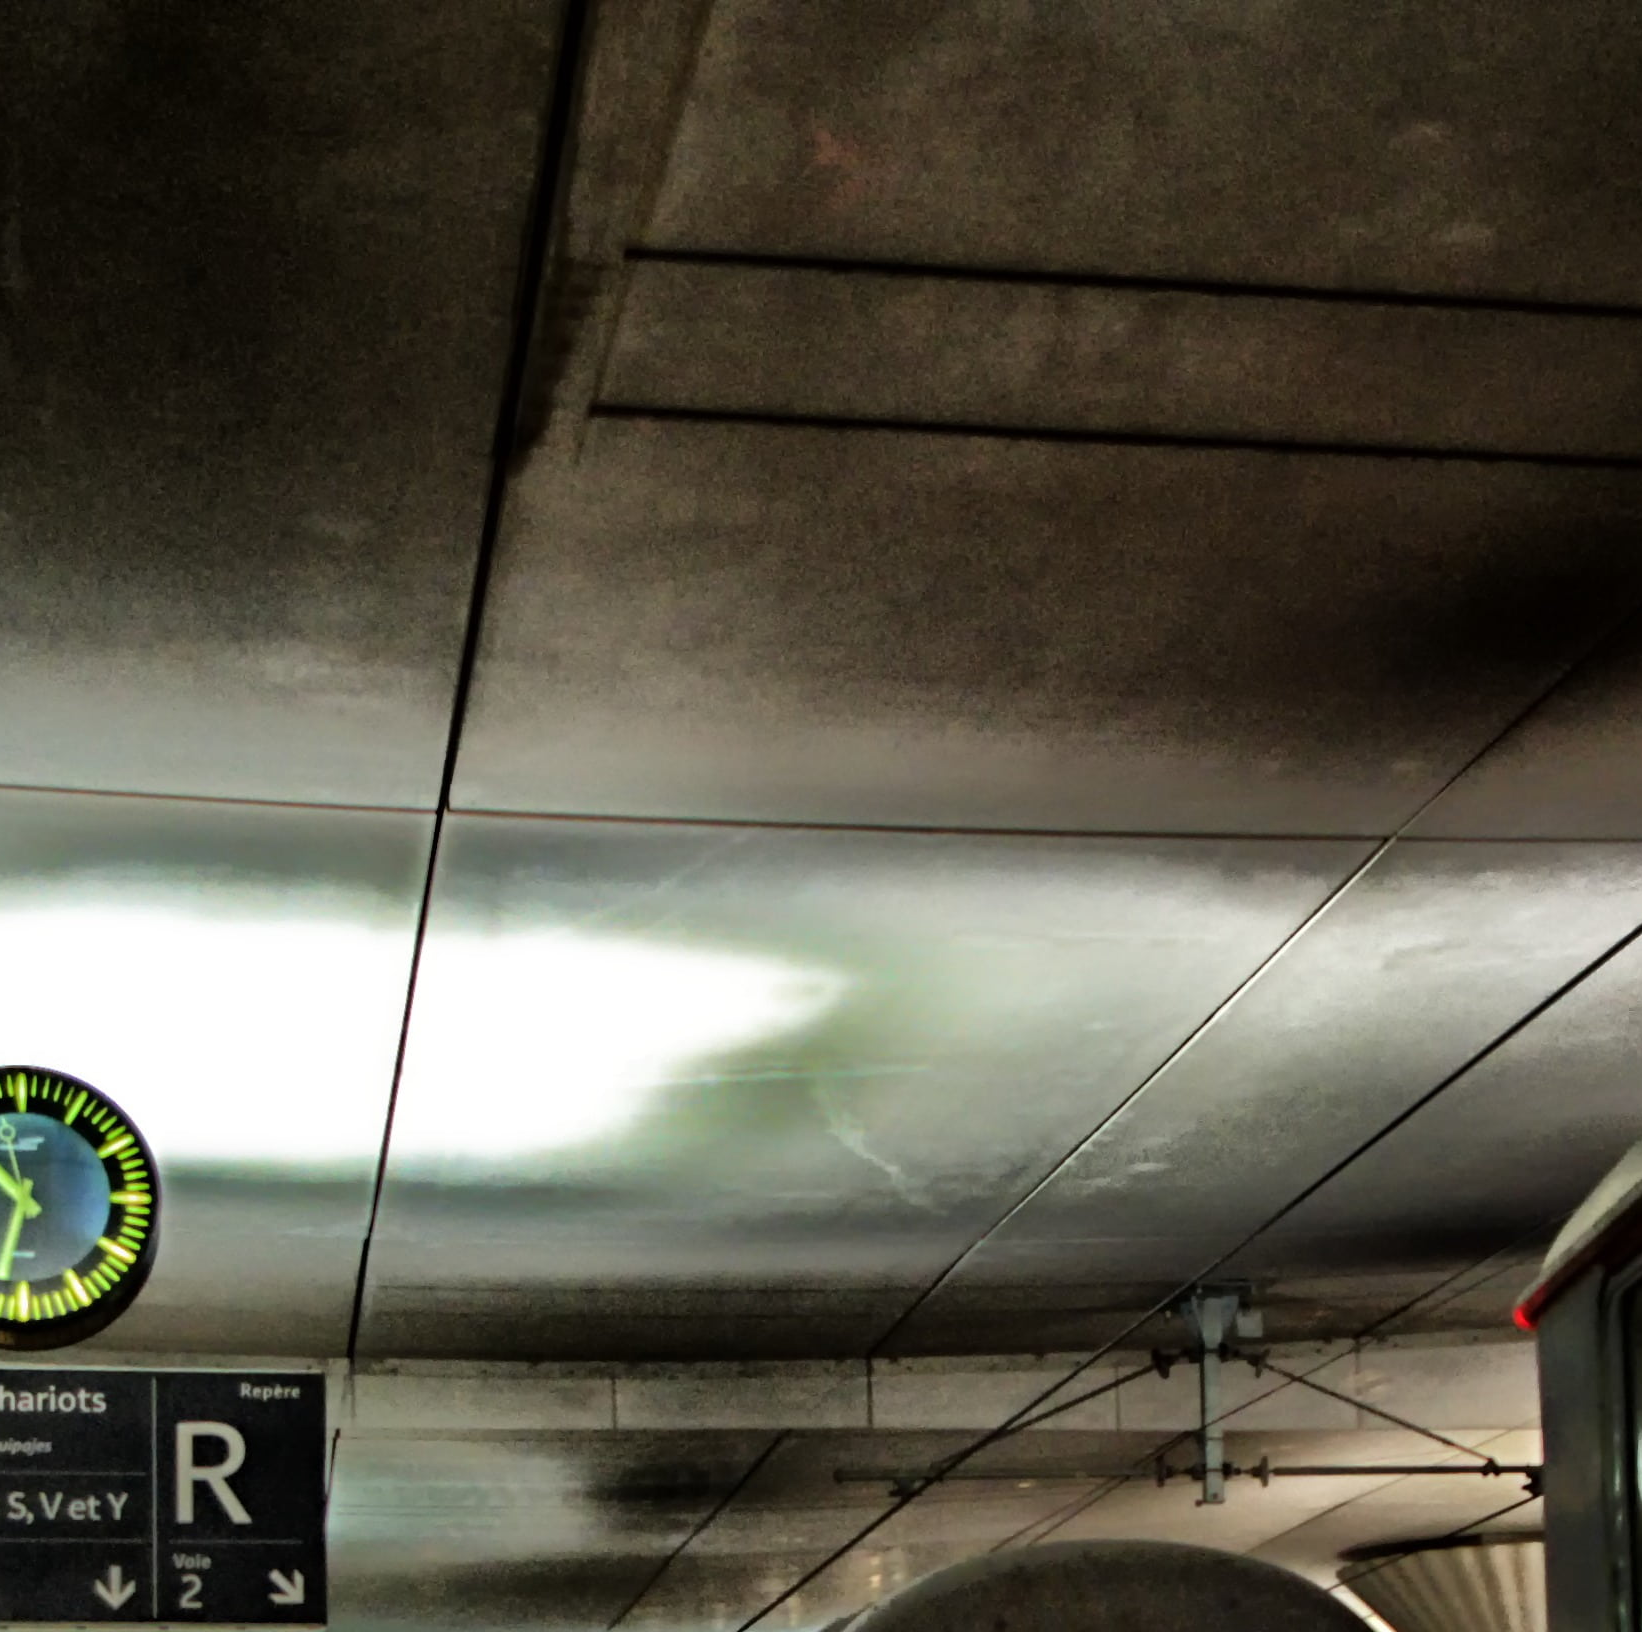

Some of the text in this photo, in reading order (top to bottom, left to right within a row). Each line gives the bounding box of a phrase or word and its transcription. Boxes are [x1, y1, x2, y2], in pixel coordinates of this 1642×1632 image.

[240, 1383, 301, 1401] Repère
[176, 1420, 253, 1524] R
[68, 1493, 102, 1521] et
[108, 1493, 128, 1521] Y
[172, 1554, 212, 1570] Voie
[179, 1573, 203, 1609] 2
